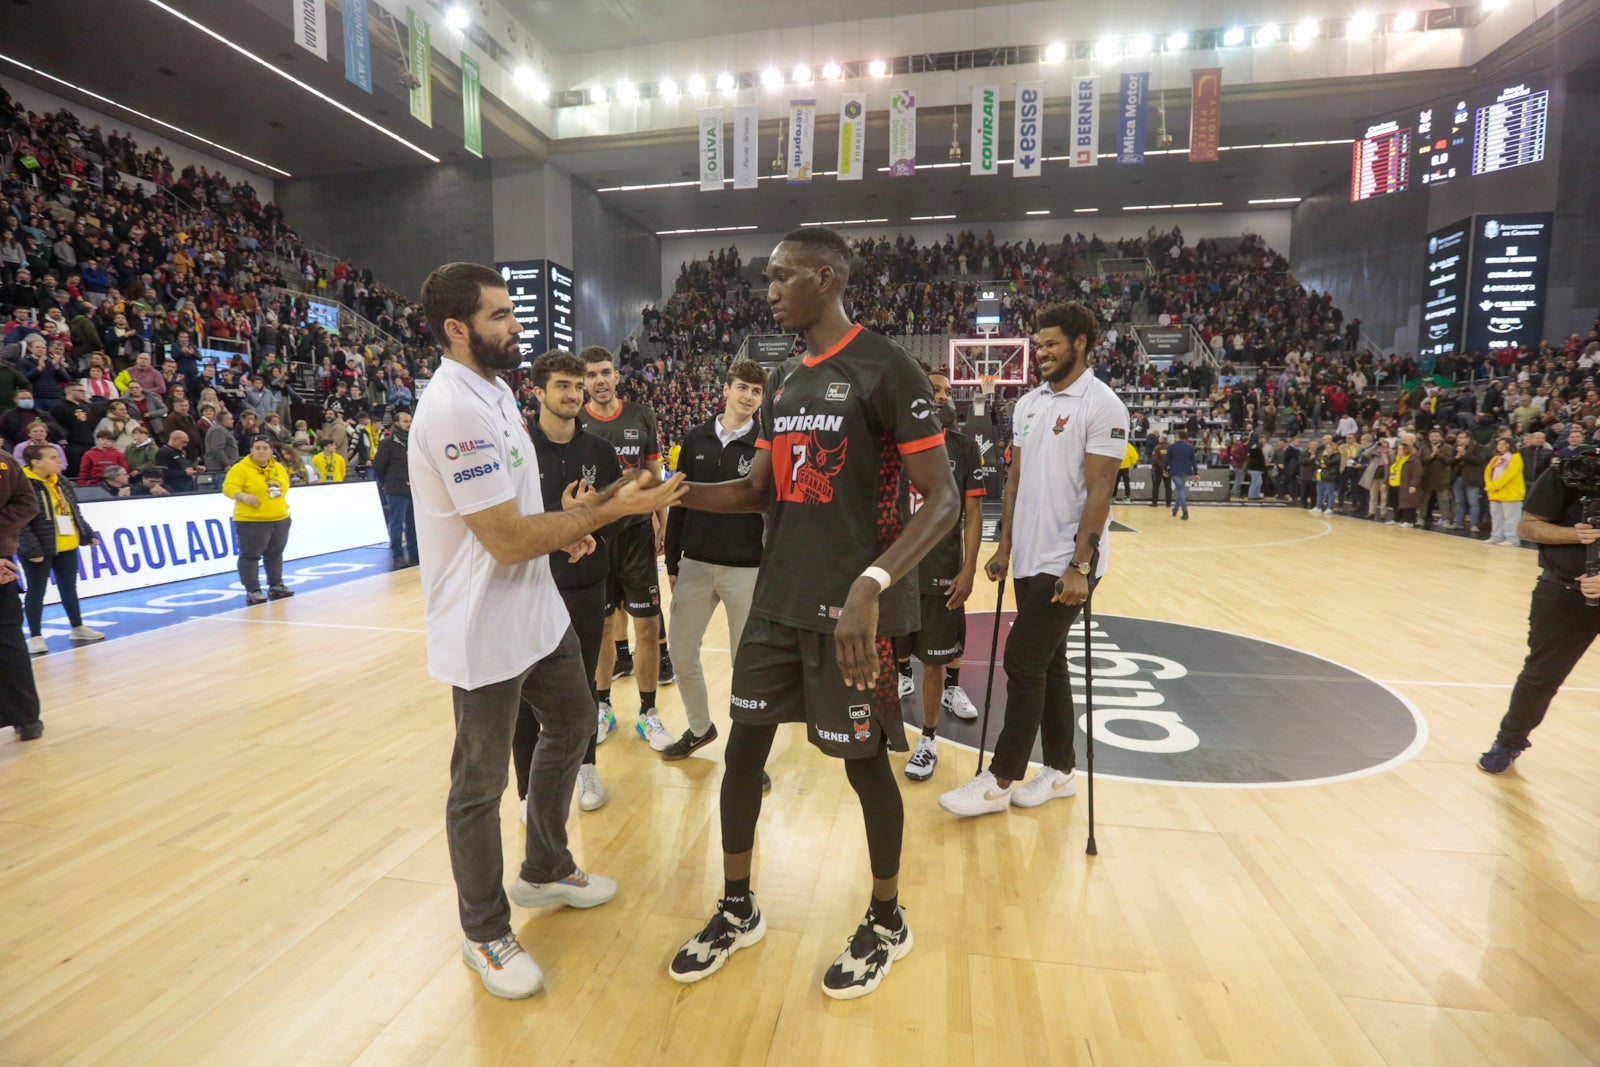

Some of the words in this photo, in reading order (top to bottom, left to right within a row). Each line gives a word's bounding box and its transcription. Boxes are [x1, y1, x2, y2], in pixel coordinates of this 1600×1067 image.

[1077, 80, 1093, 146] BERNER
[1125, 75, 1139, 117] Motor
[793, 109, 803, 168] aeroprint
[1020, 89, 1038, 151] asisa
[1123, 120, 1136, 153] Mica
[1206, 100, 1216, 157] ANTONIO
[704, 127, 717, 172] OLIVA
[773, 406, 844, 433] OVIRAN
[458, 440, 476, 453] HLA
[792, 444, 807, 482] 7
[453, 462, 493, 484] asisa
